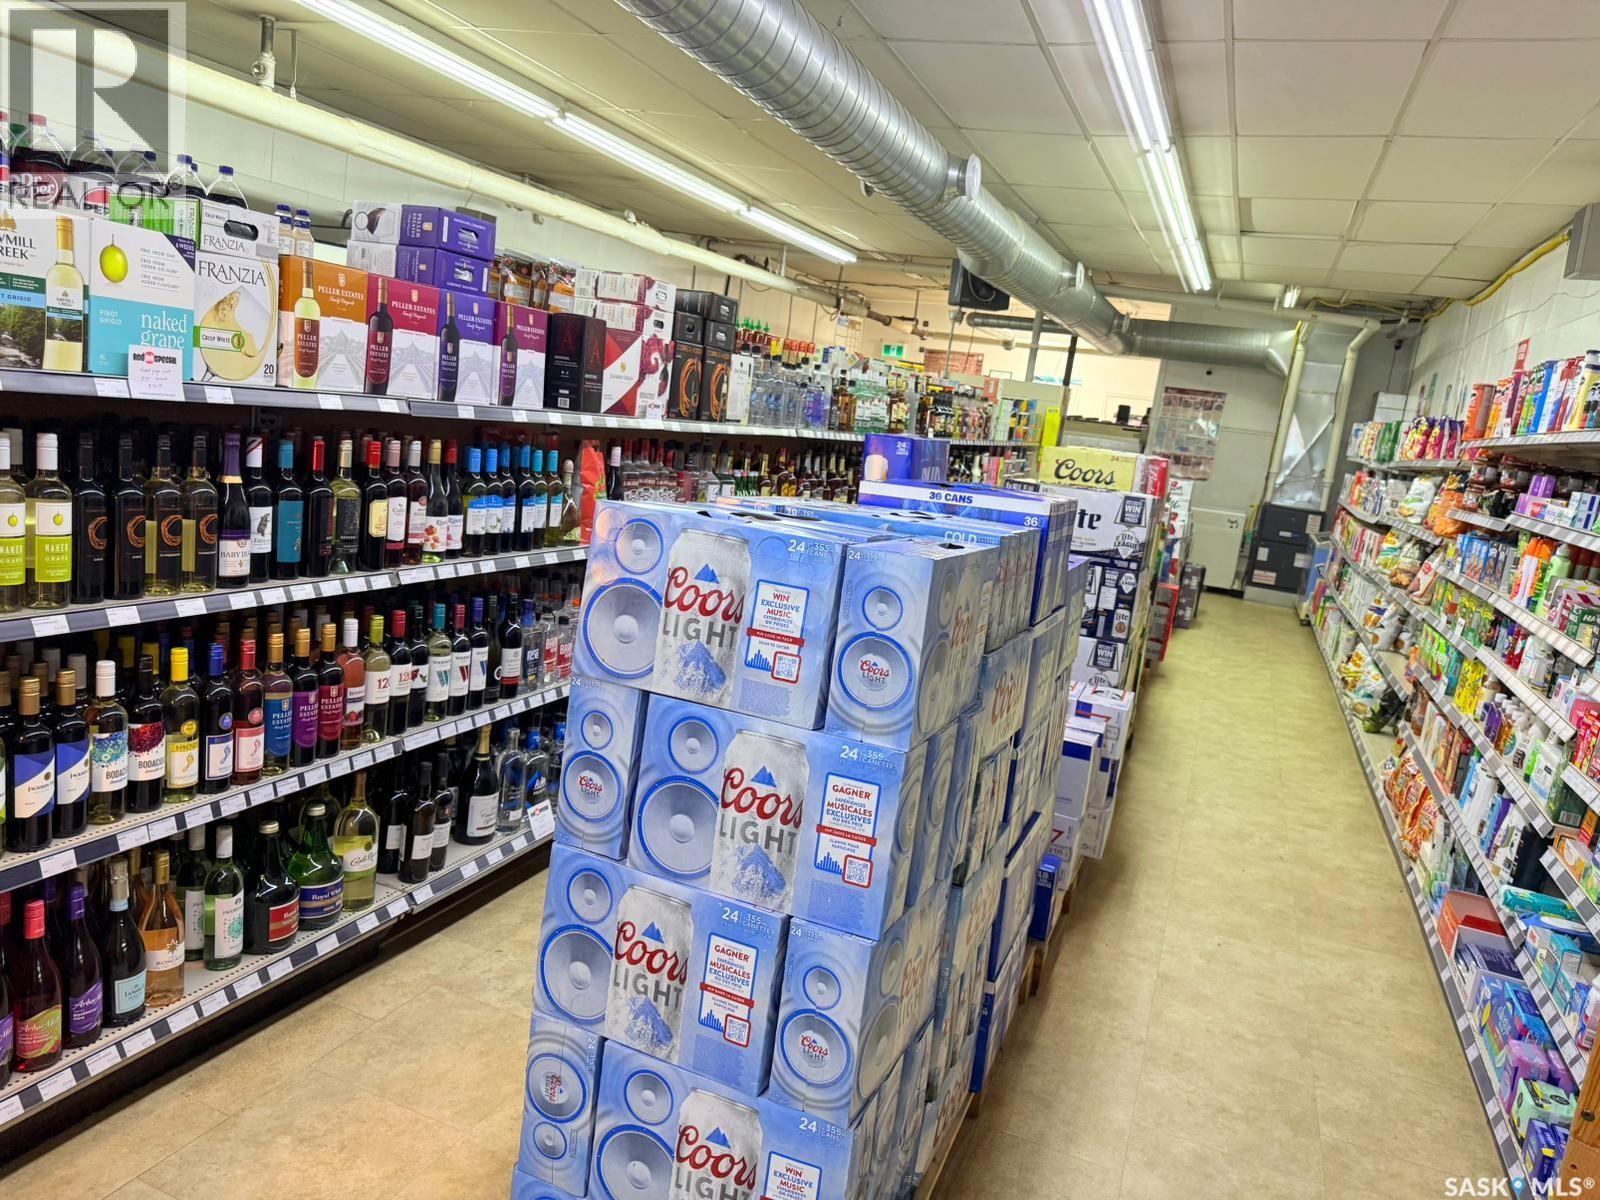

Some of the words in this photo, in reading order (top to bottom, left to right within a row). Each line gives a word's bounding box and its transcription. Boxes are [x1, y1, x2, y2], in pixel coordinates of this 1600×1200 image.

[203, 235, 245, 252] FRANZIA
[199, 261, 266, 286] FRANZIA
[318, 285, 340, 296] PELLER
[341, 290, 364, 300] ESTATES
[391, 300, 413, 310] PELLER
[413, 305, 435, 315] ESTATES
[141, 311, 187, 333] naked
[141, 330, 185, 349] grape
[202, 334, 216, 342] CRISP
[217, 336, 231, 344] WHITE
[264, 364, 274, 374] 20
[1055, 459, 1115, 485] Coors
[929, 490, 943, 501] 36
[945, 492, 973, 504] CANS
[1125, 504, 1141, 513] WIN
[1024, 516, 1039, 527] 36
[945, 531, 977, 545] COLD
[788, 540, 806, 553] 24
[848, 551, 861, 560] 24
[664, 566, 746, 624] Coors
[773, 592, 790, 602] WIN
[761, 599, 800, 612] EXCLUSIVE
[766, 608, 792, 619] MUSIC
[1115, 612, 1129, 621] Lite
[662, 612, 738, 649] LIGHT
[527, 649, 539, 660] ICE
[1097, 649, 1113, 658] WIN
[860, 660, 890, 678] Coors
[571, 678, 581, 686] 24
[862, 672, 887, 685] LIGHT
[840, 746, 858, 761] 24
[580, 776, 603, 792] Coors
[832, 784, 872, 800] GAGNER
[581, 788, 600, 797] LIGHT
[721, 767, 804, 829] Coors
[826, 801, 873, 818] MUSICALES
[826, 808, 872, 825] EXCLUSIVES
[719, 813, 799, 856] LIGHT
[721, 907, 739, 923] 24
[790, 926, 802, 937] 24
[615, 921, 689, 986] Coors
[714, 944, 750, 962] GAGNER
[708, 968, 750, 987] EXCLUSIVES
[709, 960, 751, 979] MUSICALES
[612, 965, 683, 1010] LIGHT
[801, 1034, 829, 1056] Coors
[799, 1117, 817, 1133] 24
[676, 1125, 757, 1190] Coors
[773, 1171, 813, 1188] EXCLUSIVE
[785, 1166, 803, 1178] WIN
[779, 1180, 805, 1193] MUSIC
